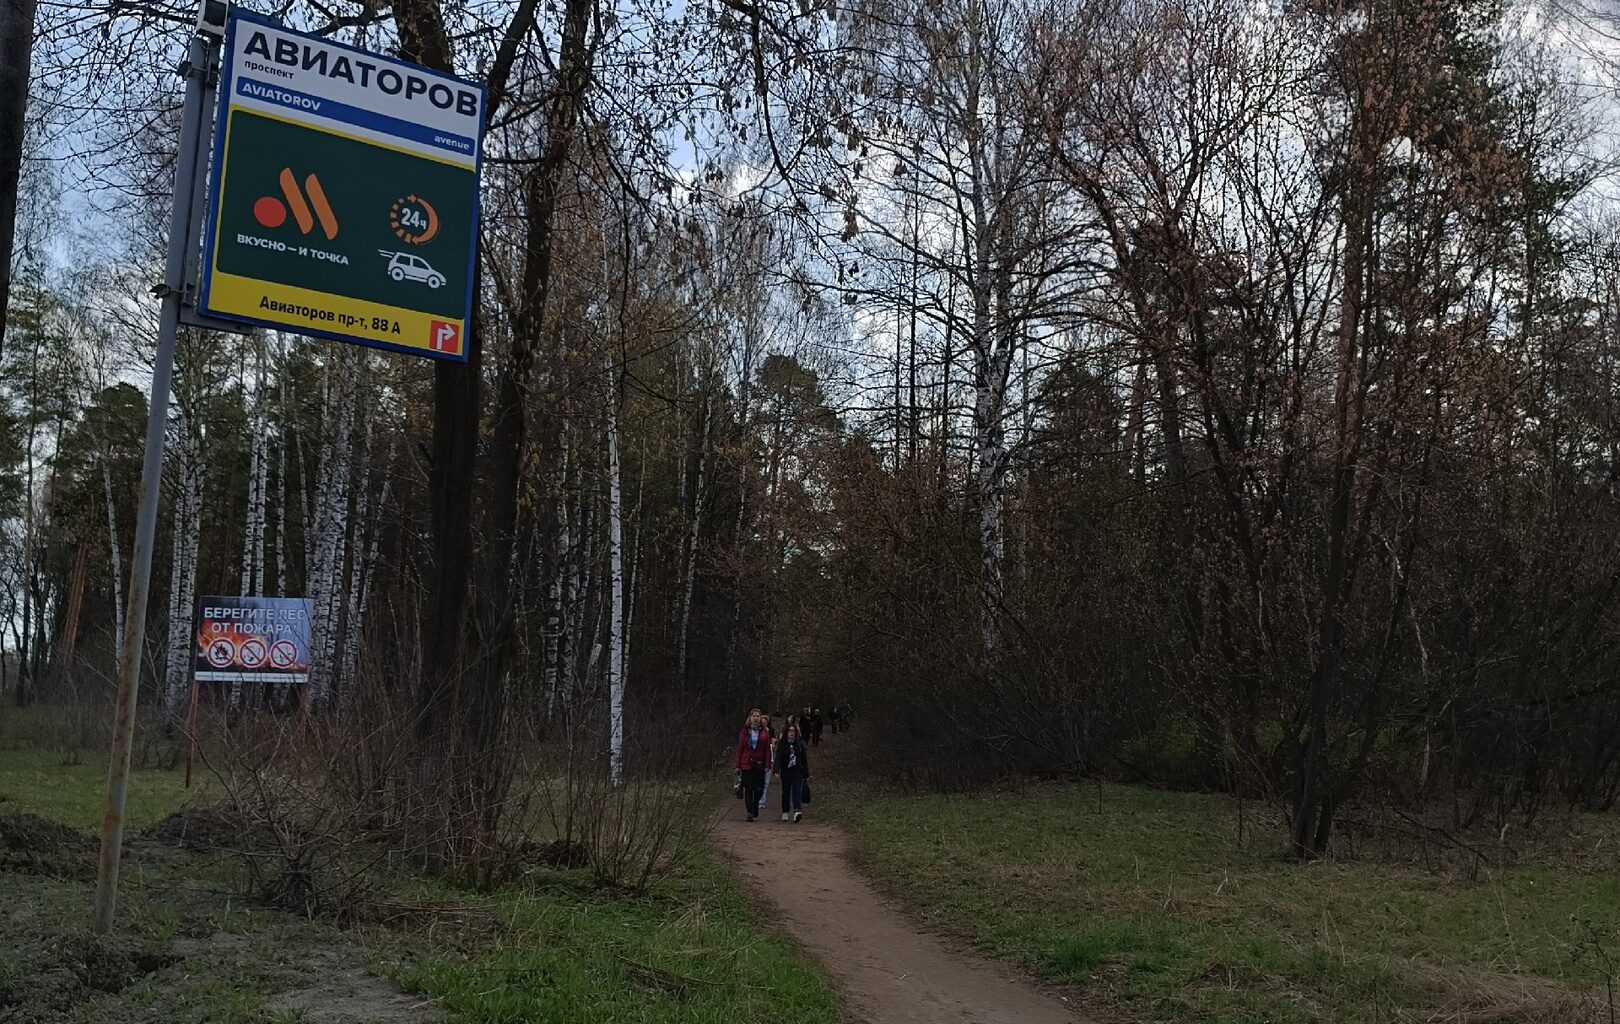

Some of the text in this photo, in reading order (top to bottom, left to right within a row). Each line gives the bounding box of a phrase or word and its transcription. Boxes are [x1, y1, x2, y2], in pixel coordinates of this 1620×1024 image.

[244, 60, 294, 80] проспект
[244, 31, 477, 116] АВИАТОРОВ
[242, 83, 321, 110] AVIATOROV
[434, 134, 470, 150] avenue
[237, 233, 286, 251] ВКУСНО
[310, 248, 349, 265] ТОЧКА
[259, 296, 401, 335] Авиаторов пр-т, 88 А
[204, 607, 274, 619] БЕРЕГИТЕ
[211, 622, 231, 633] ОТ
